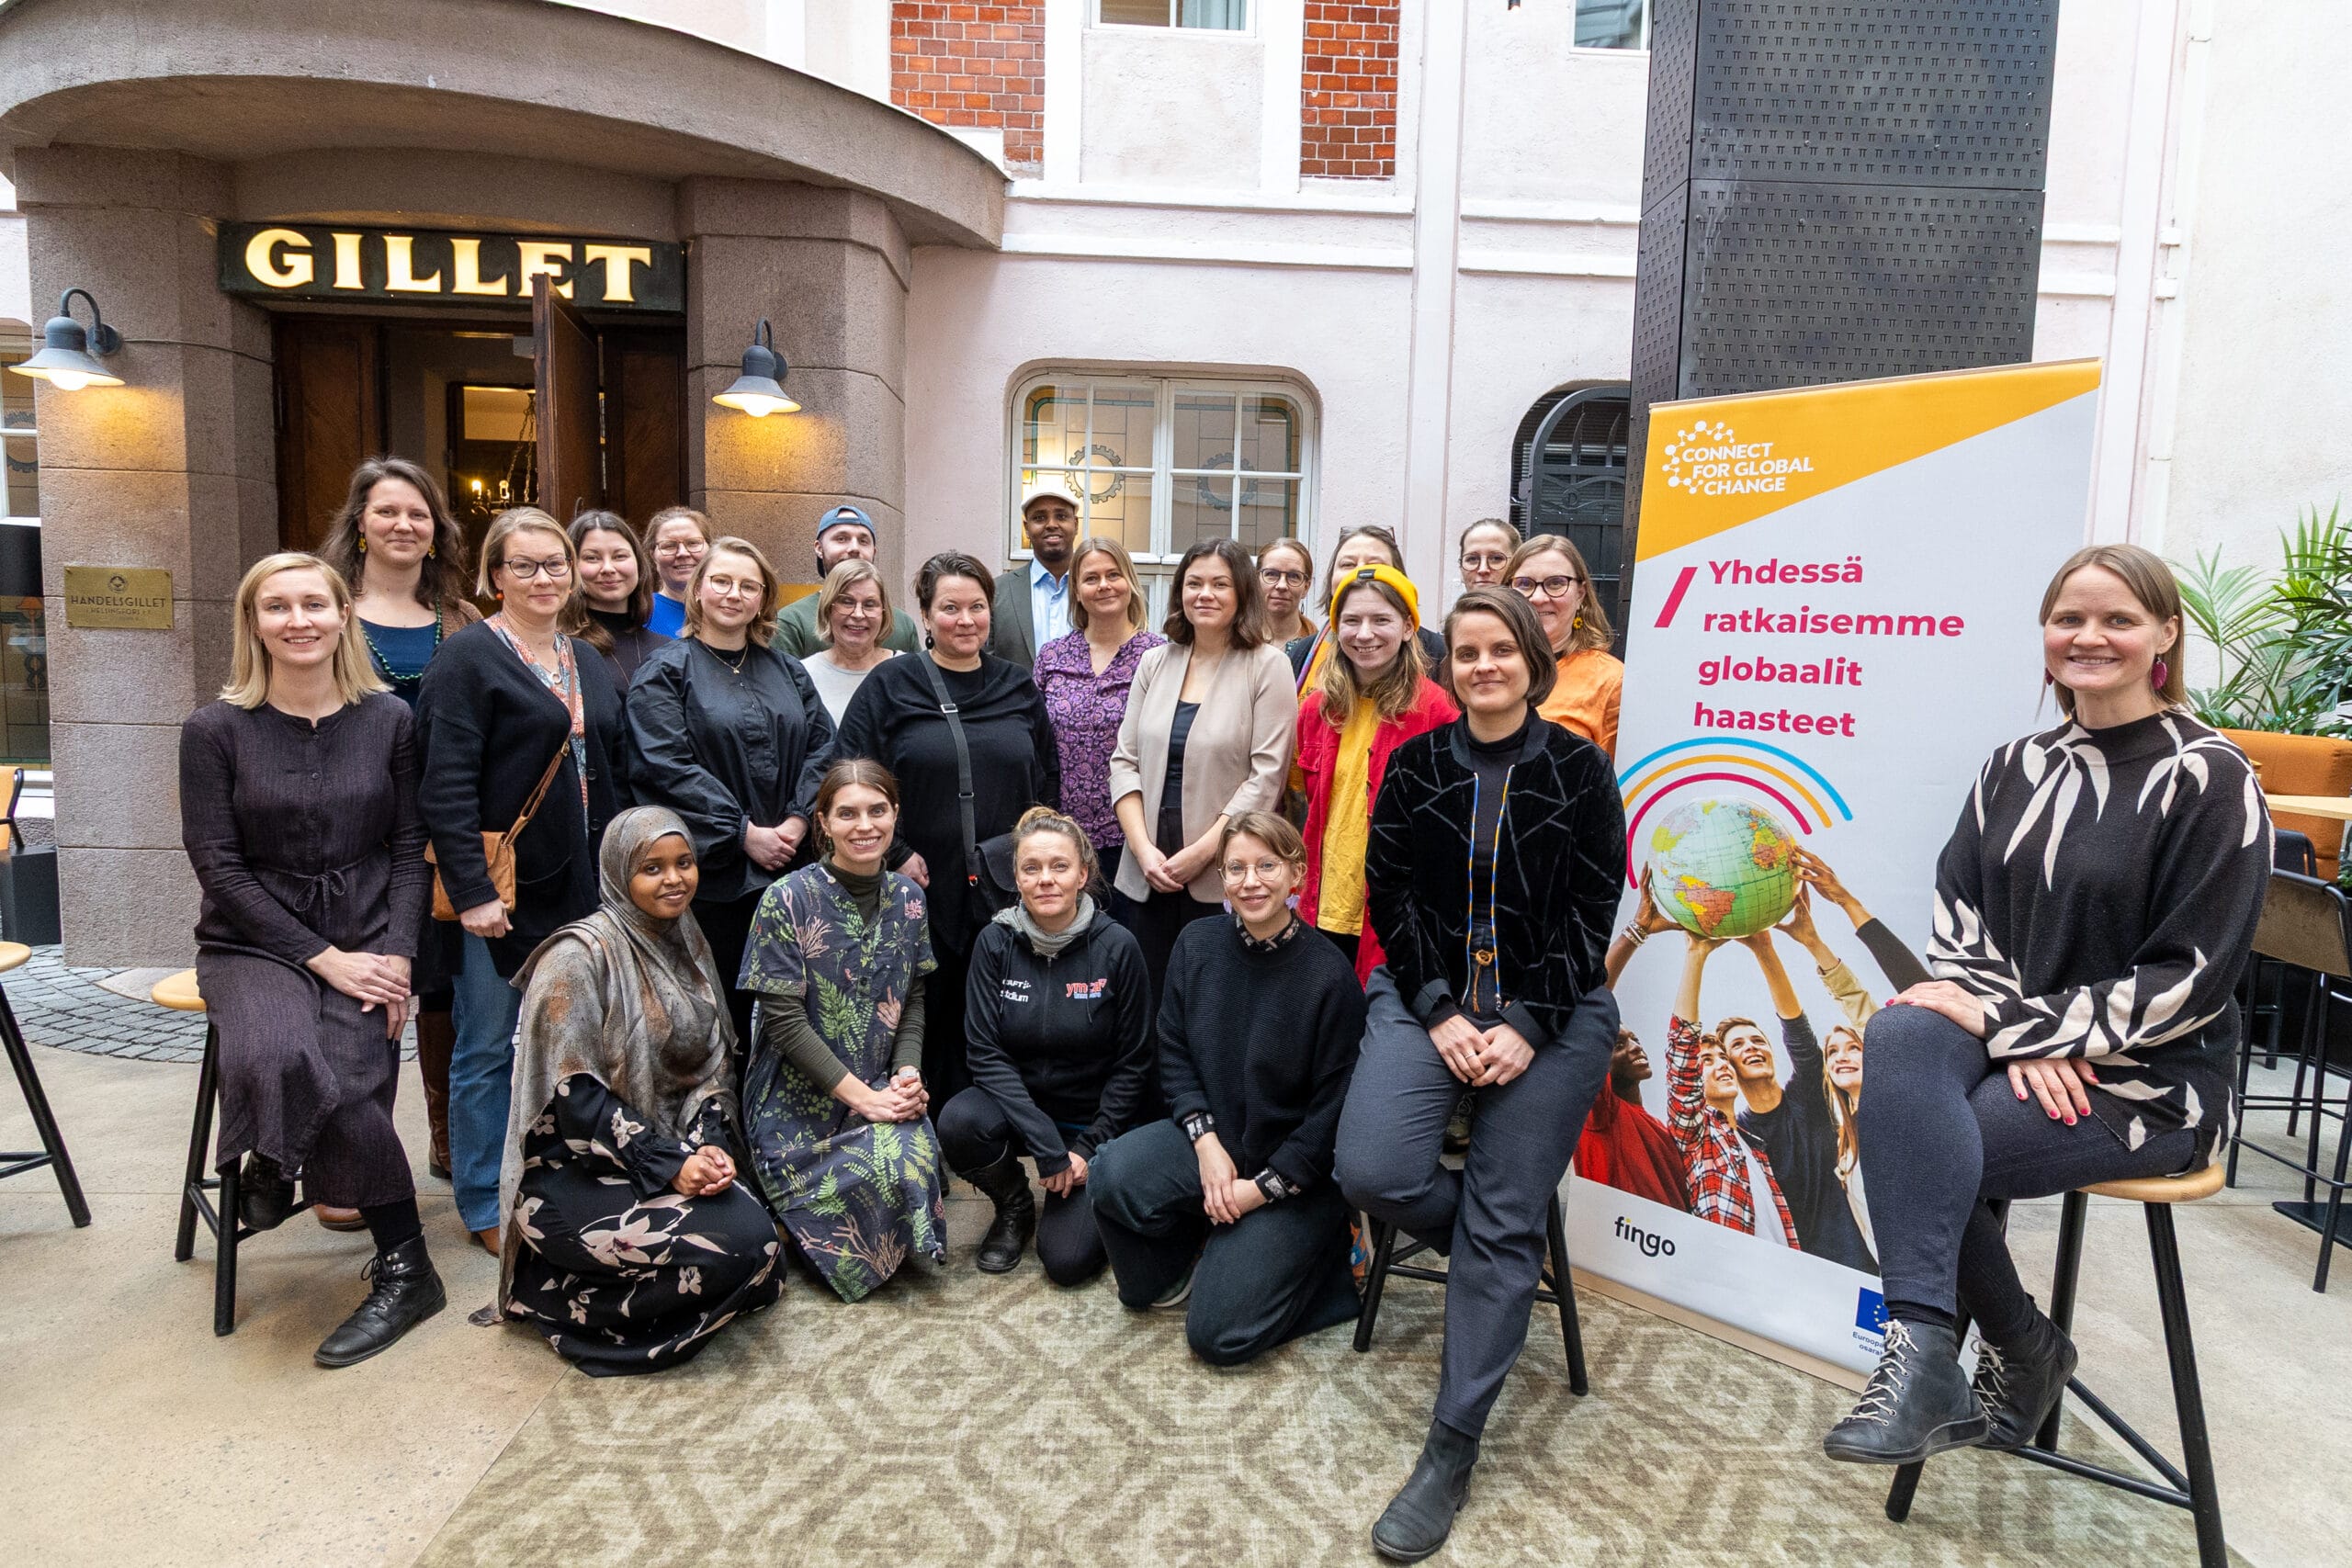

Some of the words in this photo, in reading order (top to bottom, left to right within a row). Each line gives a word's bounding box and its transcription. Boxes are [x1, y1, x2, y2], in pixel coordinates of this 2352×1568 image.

[244, 228, 651, 303] GILLET
[1682, 442, 1774, 462] CONNECT
[1692, 463, 1730, 479] FOR
[1734, 457, 1815, 477] GLOBAL
[1704, 477, 1786, 496] CHANGE
[1709, 555, 1863, 585] Yhdessä
[71, 595, 166, 608] HANDELSGILLET
[1703, 604, 1965, 637] ratkaisemme
[1698, 654, 1863, 687] globaalit
[1693, 701, 1856, 738] haasteet
[1614, 1215, 1676, 1258] fingo
[1852, 1331, 1884, 1348] Euroopa
